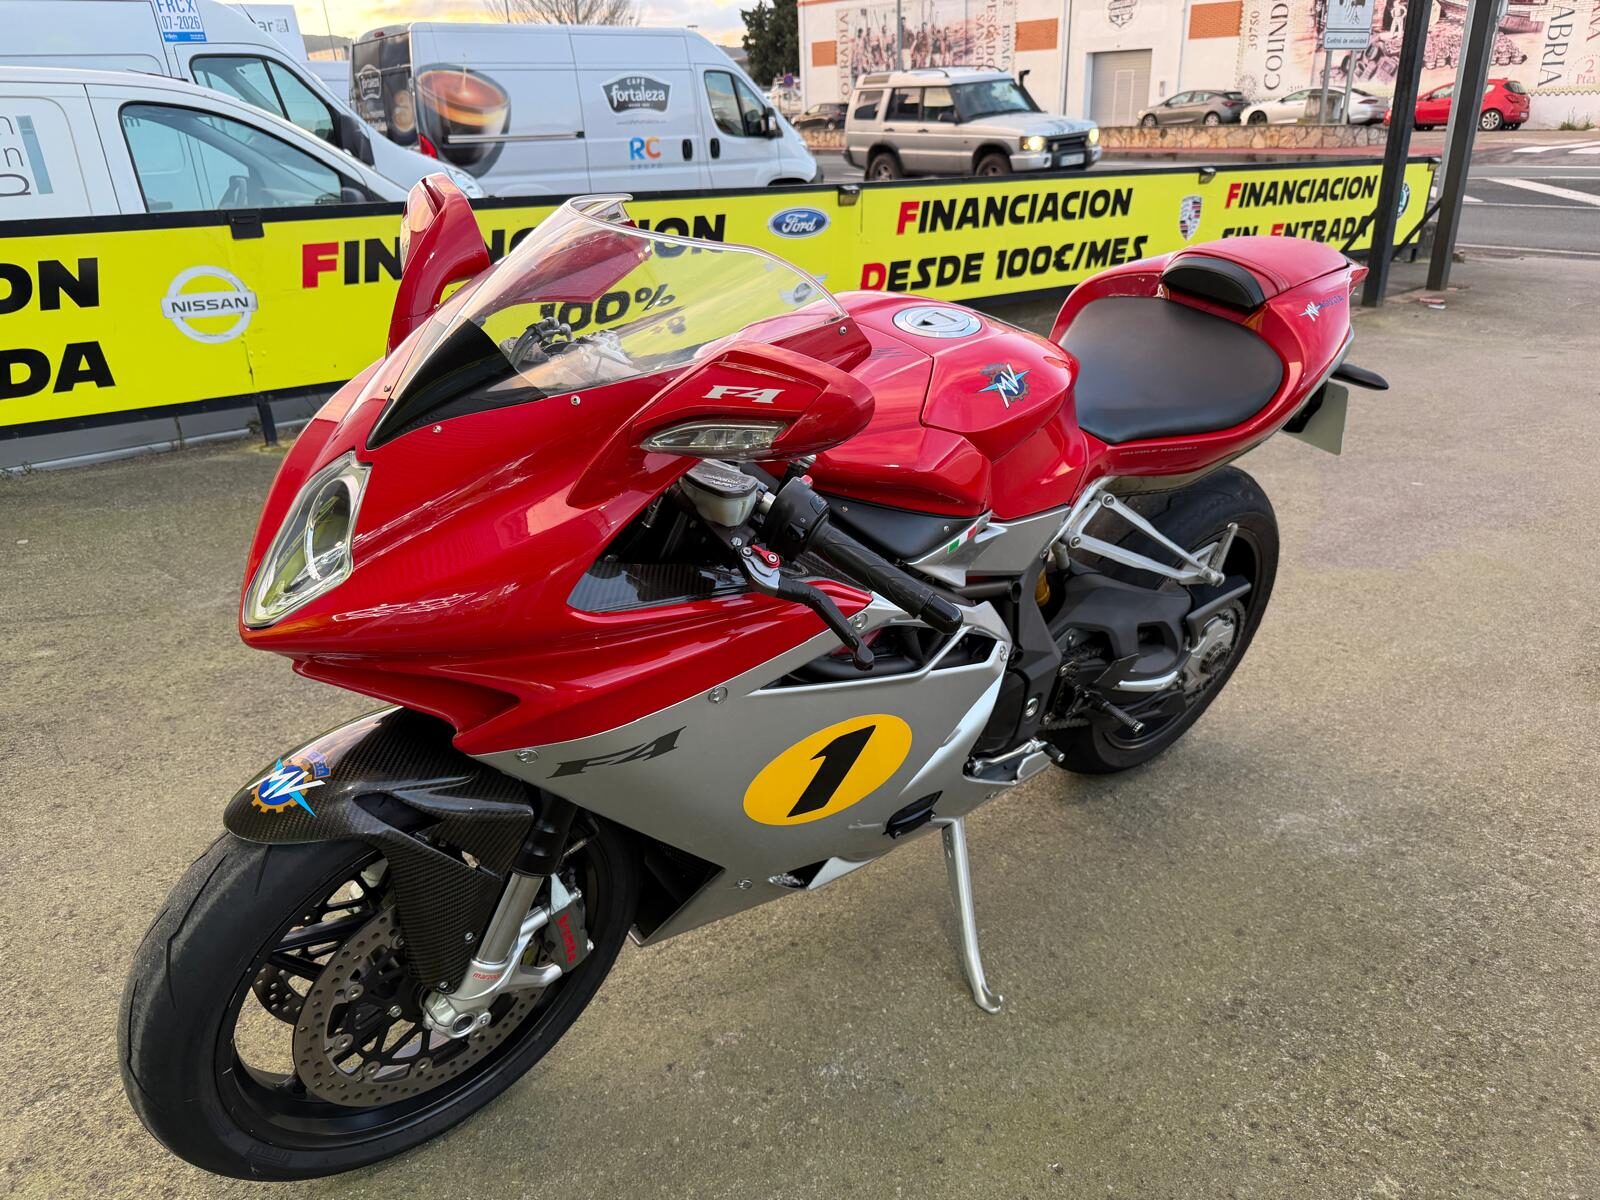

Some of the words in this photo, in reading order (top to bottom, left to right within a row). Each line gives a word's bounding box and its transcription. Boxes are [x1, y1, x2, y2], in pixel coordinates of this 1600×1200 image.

[161, 16, 201, 30] 07-2026
[1264, 0, 1290, 90] COLIND
[611, 84, 666, 109] fortaleza
[629, 136, 662, 161] RC
[1225, 176, 1378, 208] FINANCIACION
[781, 212, 818, 234] Ford
[896, 188, 1133, 235] FINANCIACION
[860, 252, 984, 291] DESDE
[996, 235, 1149, 280] 100€/MES
[171, 296, 249, 313] NISSAN
[702, 385, 785, 404] F4
[546, 726, 687, 779] F4
[786, 725, 877, 818] 1
